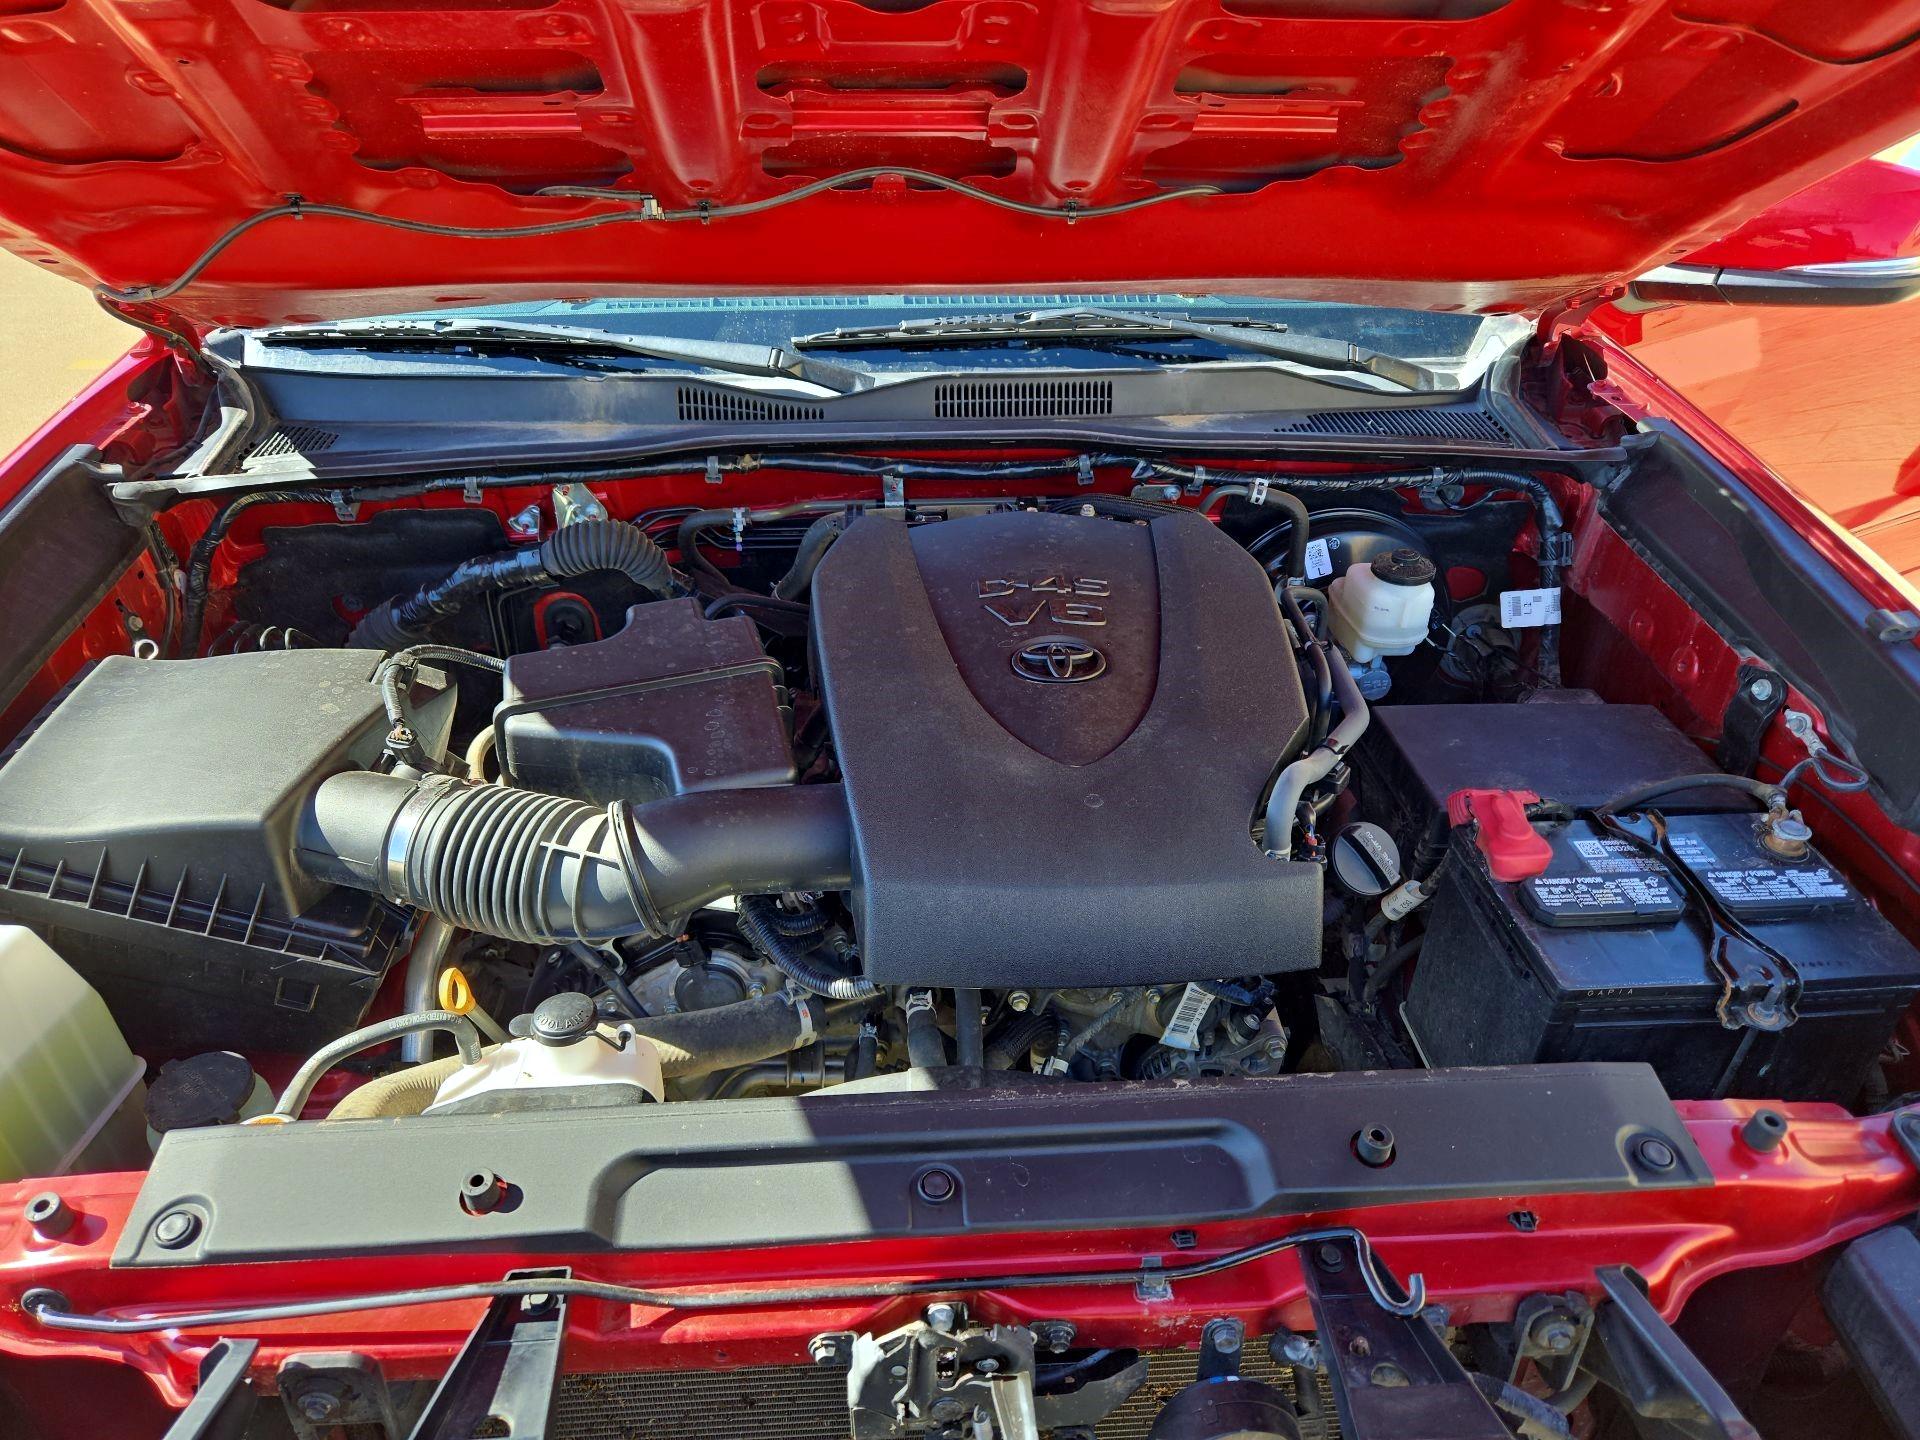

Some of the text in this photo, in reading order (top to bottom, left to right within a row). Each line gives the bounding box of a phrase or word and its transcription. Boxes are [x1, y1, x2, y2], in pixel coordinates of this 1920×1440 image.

[977, 576, 1111, 598] D-4S
[982, 599, 1107, 627] V6
[536, 1009, 589, 1032] COOLANT
